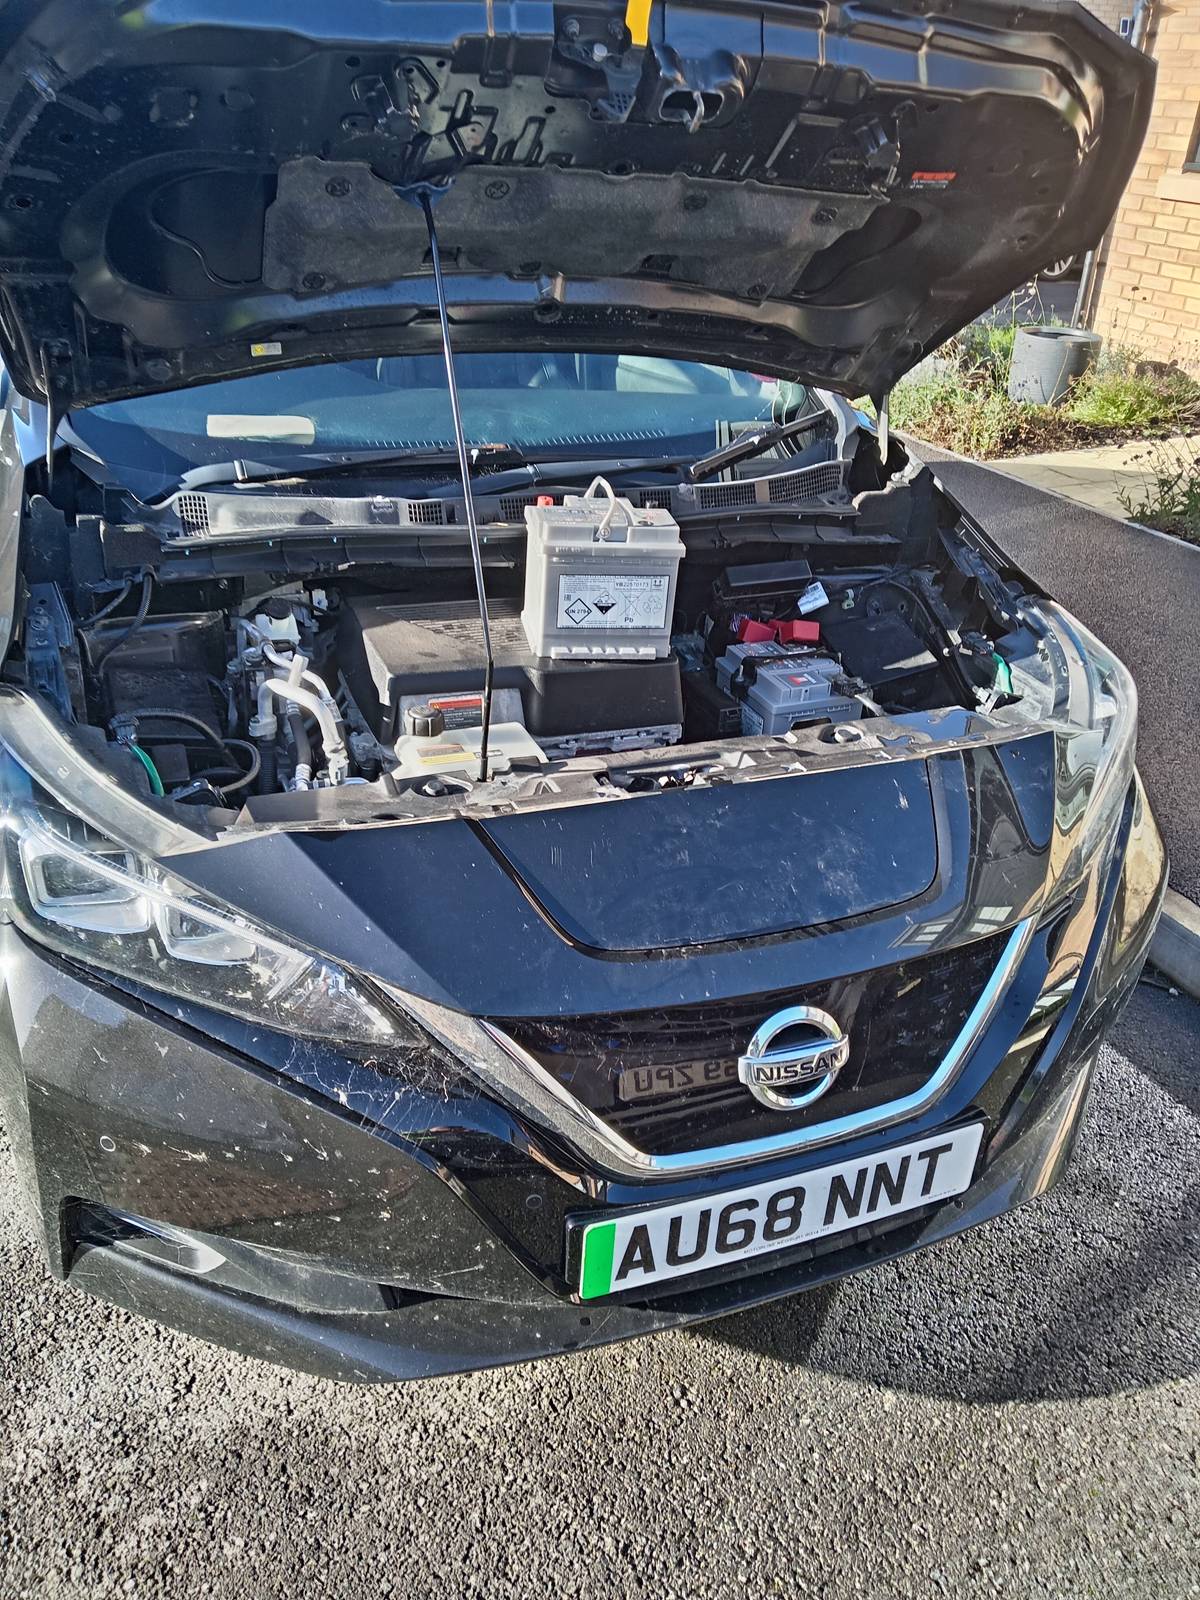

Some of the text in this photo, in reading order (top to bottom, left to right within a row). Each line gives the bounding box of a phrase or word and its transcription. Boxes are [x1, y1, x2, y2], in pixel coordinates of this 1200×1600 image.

[756, 1050, 843, 1082] NISSAN
[614, 1142, 953, 1281] AU68 NNT
